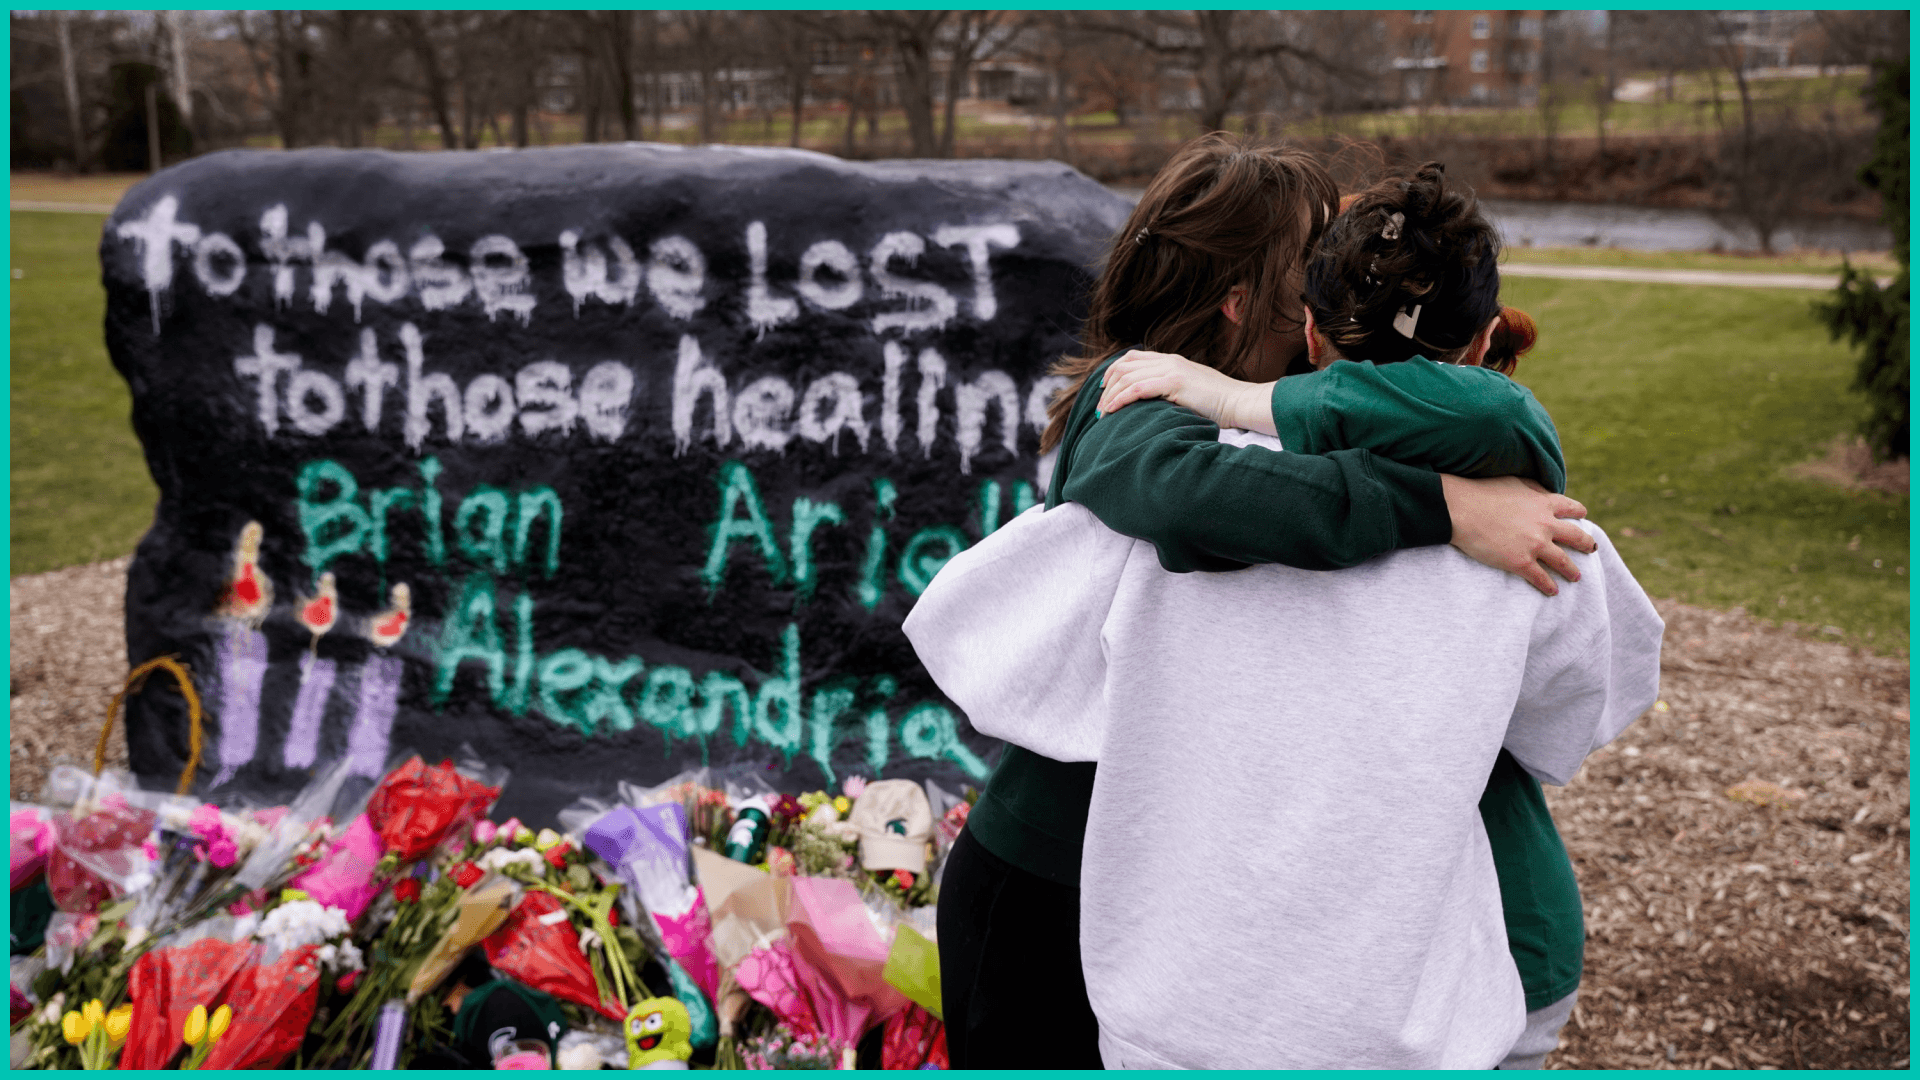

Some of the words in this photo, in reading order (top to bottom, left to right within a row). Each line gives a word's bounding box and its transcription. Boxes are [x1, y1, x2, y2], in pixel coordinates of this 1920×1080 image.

[559, 228, 707, 320] we
[296, 455, 564, 582] Brian
[430, 572, 991, 784] Alexandria
